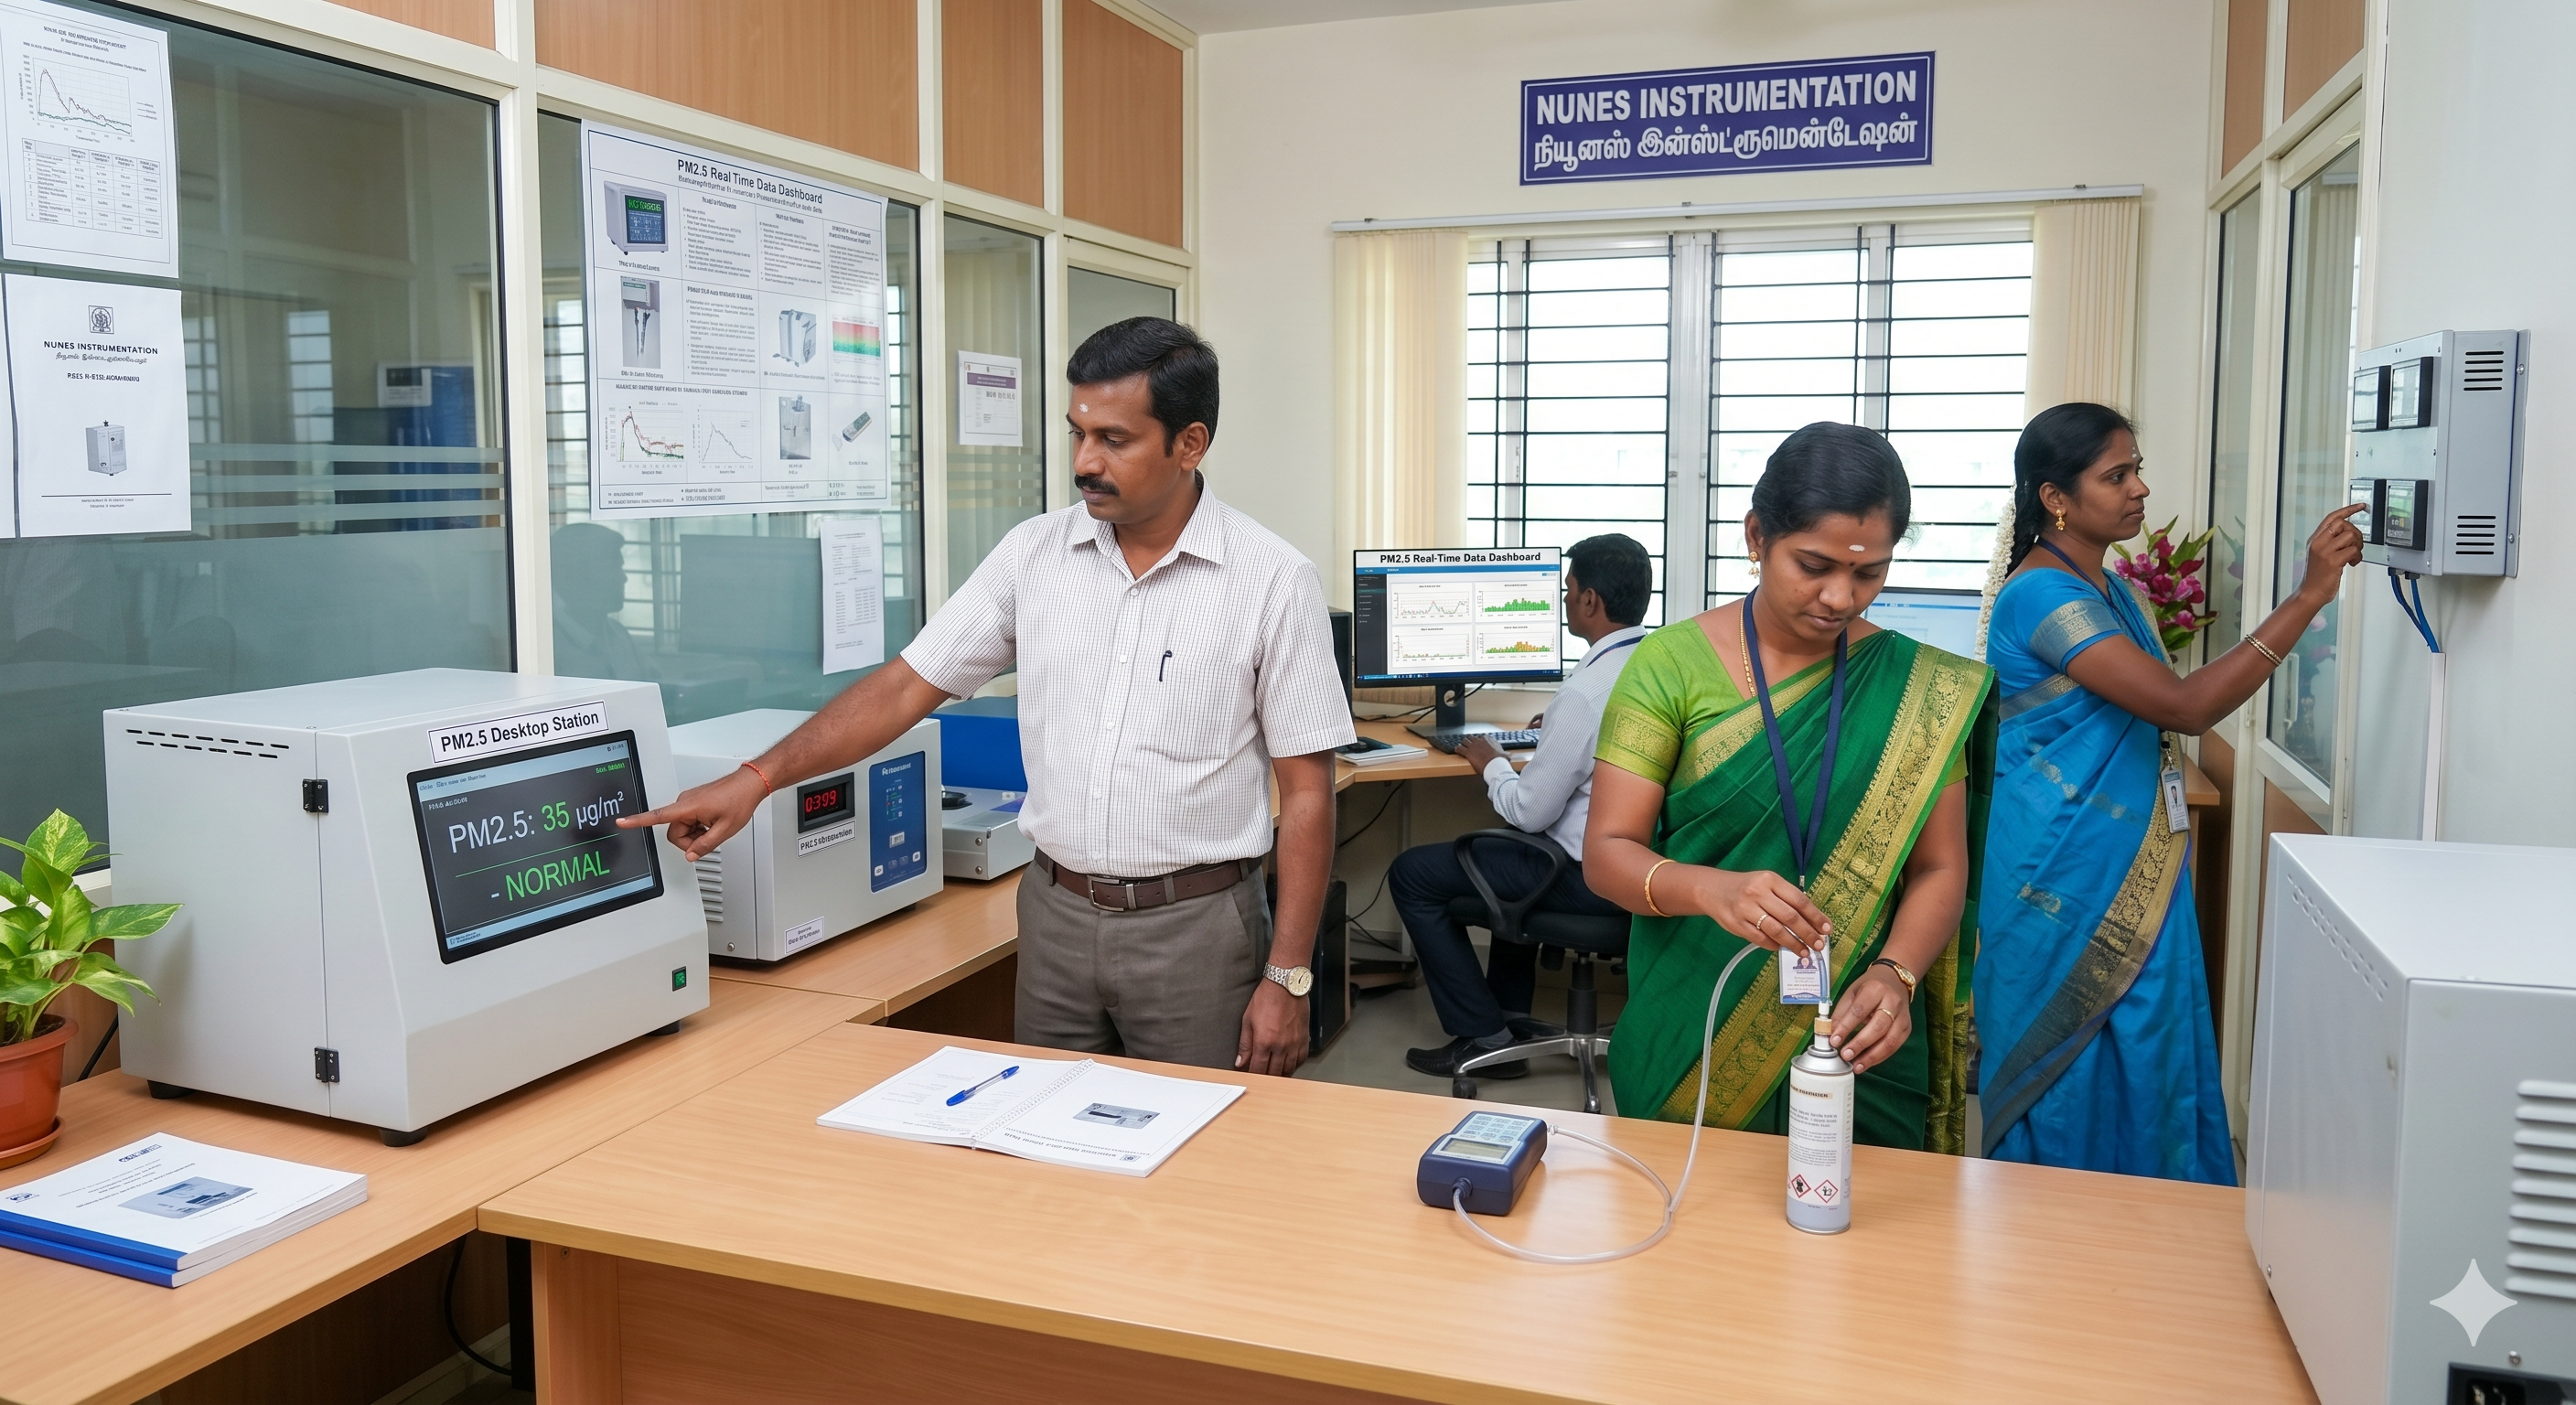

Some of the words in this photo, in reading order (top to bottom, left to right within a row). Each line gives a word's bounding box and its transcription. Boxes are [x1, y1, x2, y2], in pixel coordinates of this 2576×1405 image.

[1537, 90, 1630, 124] NUNES
[1640, 70, 1916, 118] INSTRUMENTATION
[1534, 130, 1631, 172] நியூனஸ்
[678, 159, 708, 177] PM2.5
[711, 166, 731, 183] Real
[733, 172, 755, 188] Time
[757, 177, 777, 194] Data
[778, 183, 823, 204] Dashboard
[44, 341, 75, 349] NUNES
[78, 343, 158, 354] INSTRUMENTATION
[1413, 553, 1461, 563] Real-Time
[1464, 553, 1487, 563] Data
[1488, 552, 1540, 563] Dashboard
[441, 729, 488, 753] PM2.5
[490, 721, 550, 743] Desktop
[552, 711, 600, 731] Station
[448, 810, 536, 853] PM2.5:
[542, 801, 570, 831] 35
[506, 851, 610, 901] NORMAL
